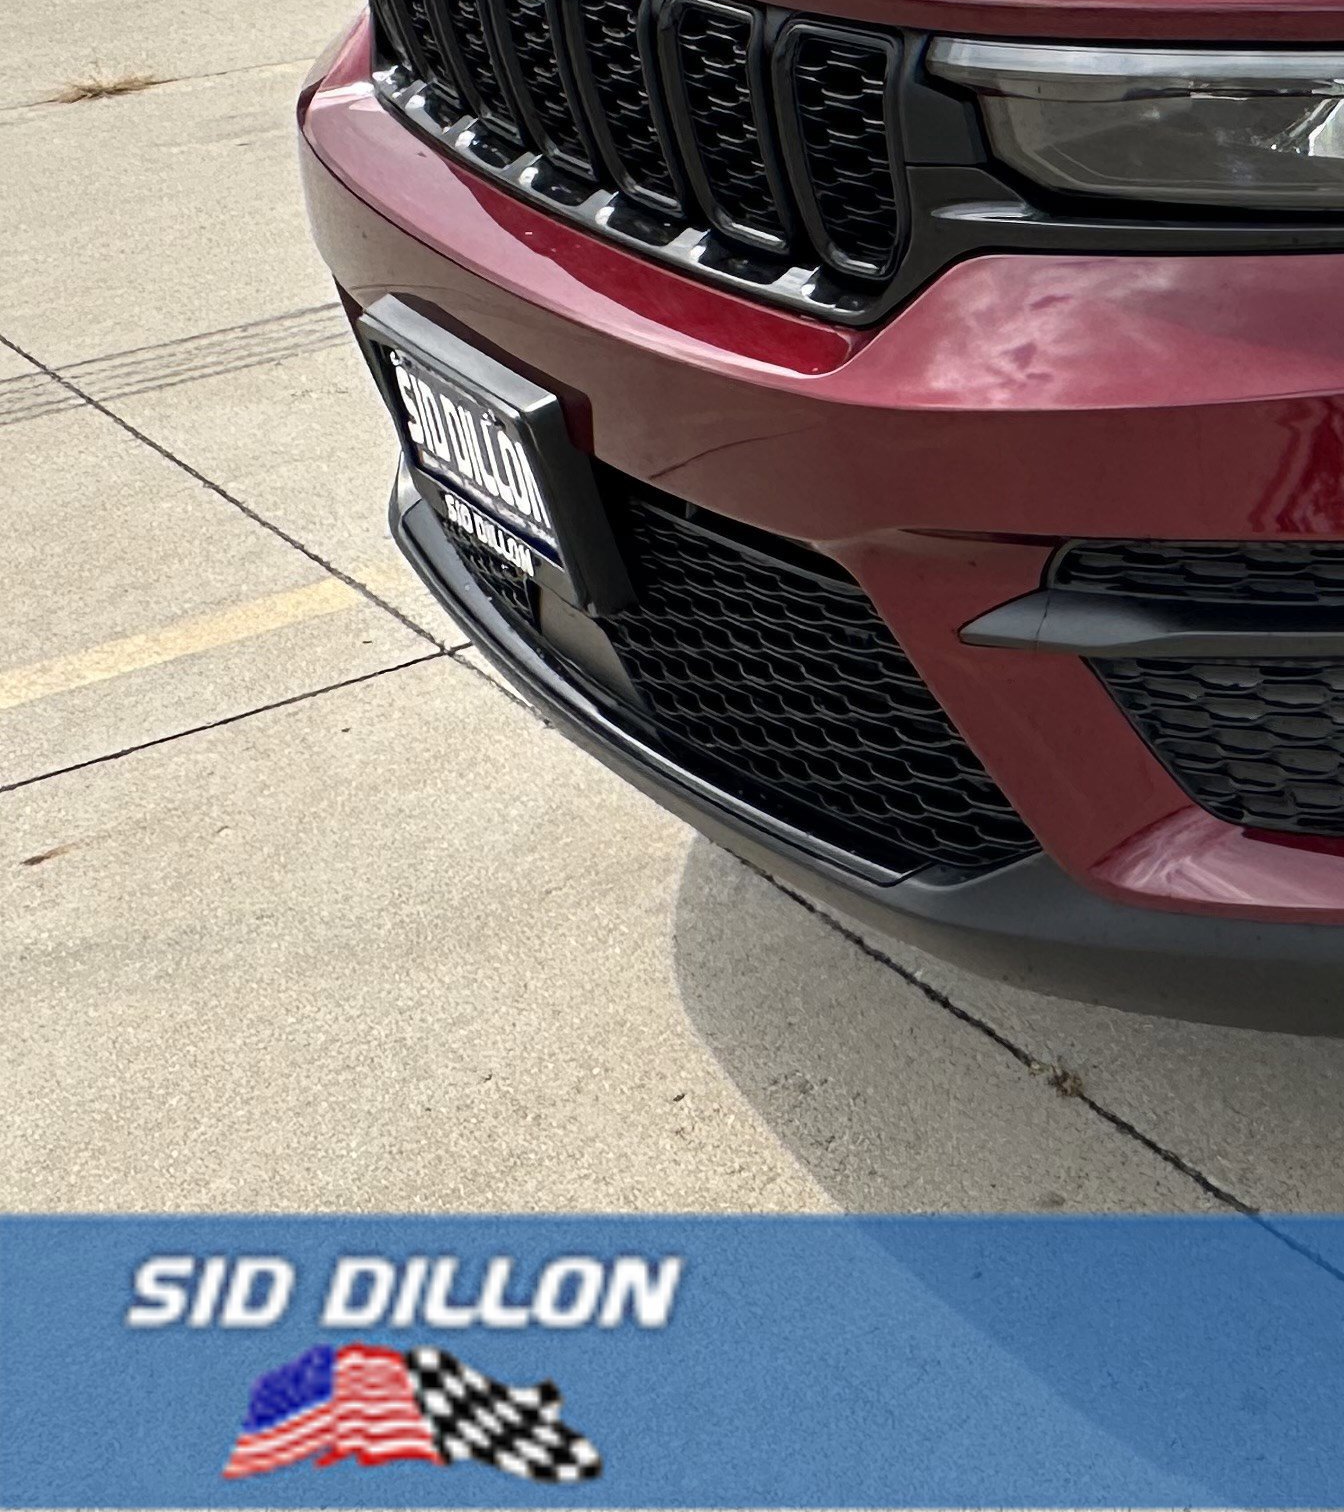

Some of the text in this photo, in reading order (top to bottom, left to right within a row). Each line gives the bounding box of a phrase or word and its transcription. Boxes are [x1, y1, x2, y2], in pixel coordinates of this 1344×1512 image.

[394, 364, 552, 529] SID DILLON
[444, 493, 536, 578] SID DILLON
